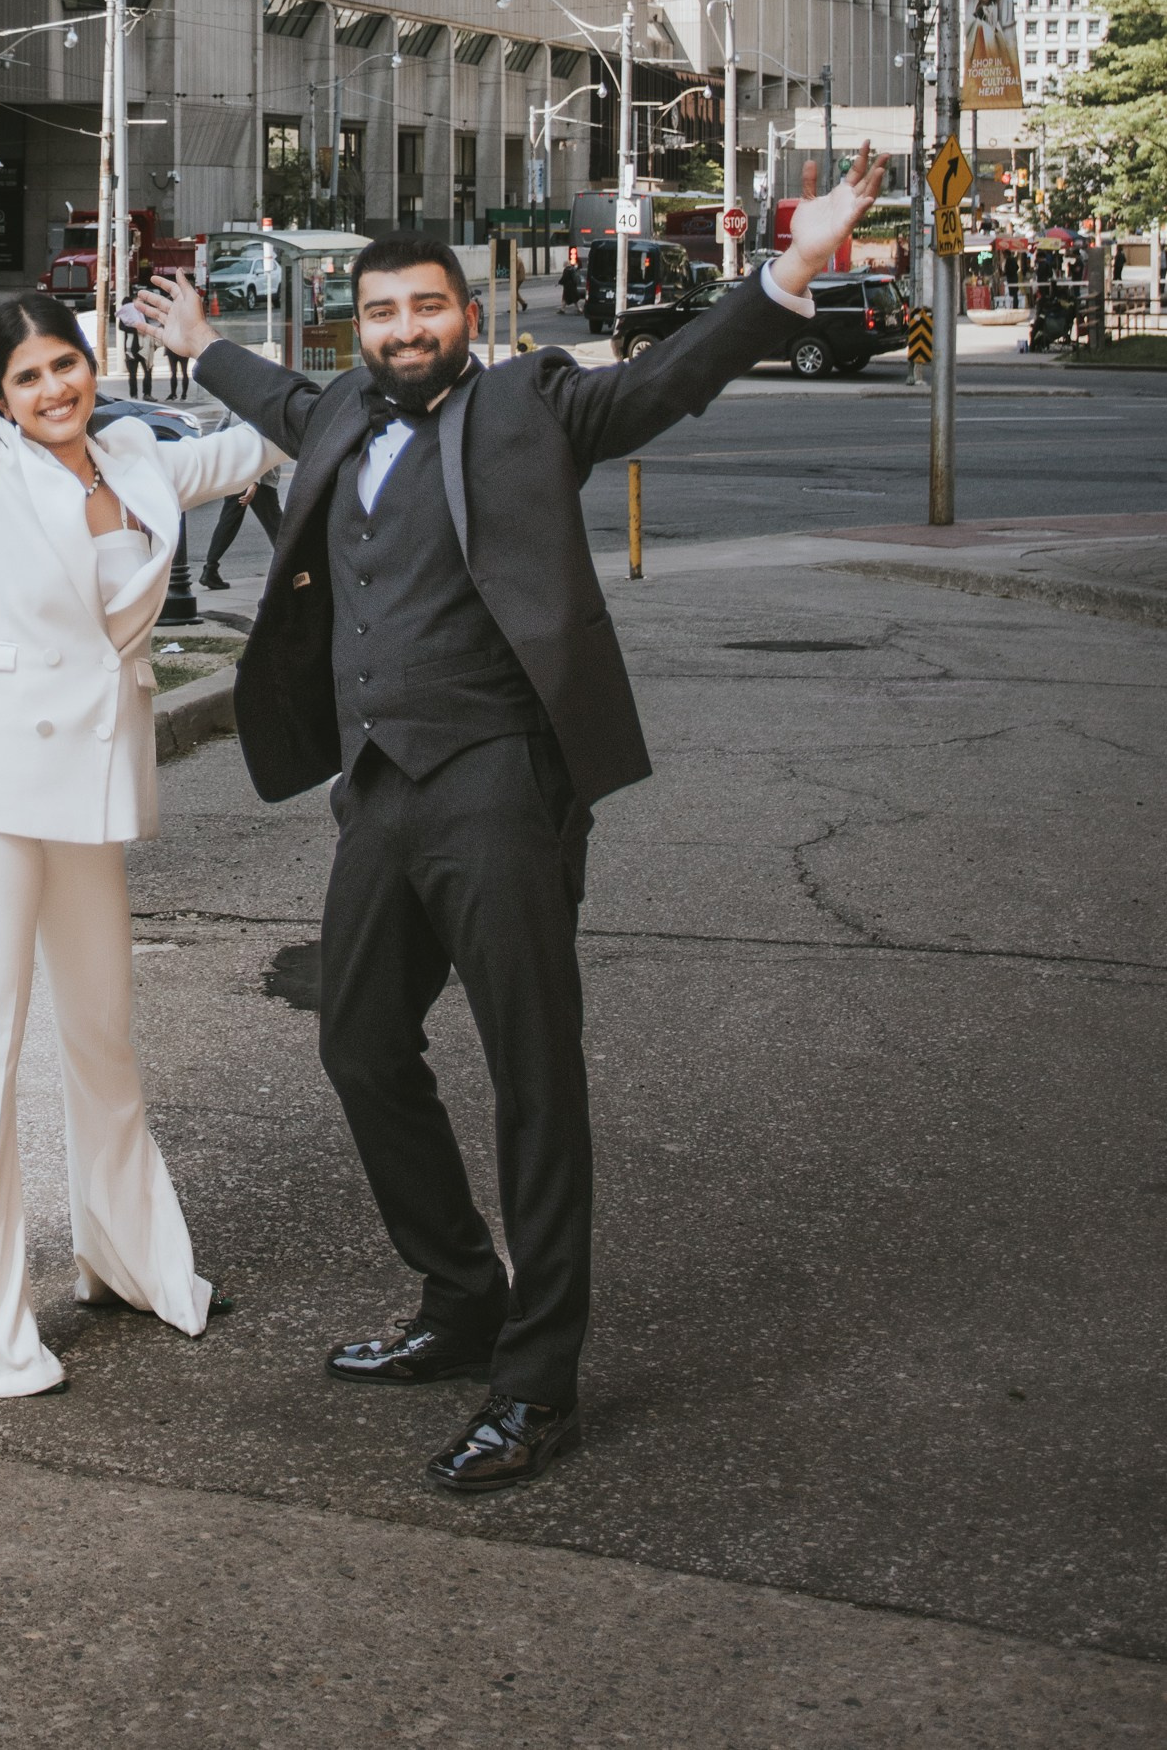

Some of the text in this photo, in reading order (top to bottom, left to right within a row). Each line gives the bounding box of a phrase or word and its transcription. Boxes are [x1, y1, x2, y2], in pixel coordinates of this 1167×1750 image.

[972, 58, 1002, 69] SHOP IN
[968, 66, 1011, 78] TORONTO'S
[982, 76, 1020, 87] CULTURAL
[978, 87, 1004, 97] HEART
[618, 213, 638, 228] 40
[724, 216, 746, 228] STOP
[941, 210, 957, 234] 20
[938, 237, 962, 251] km/h
